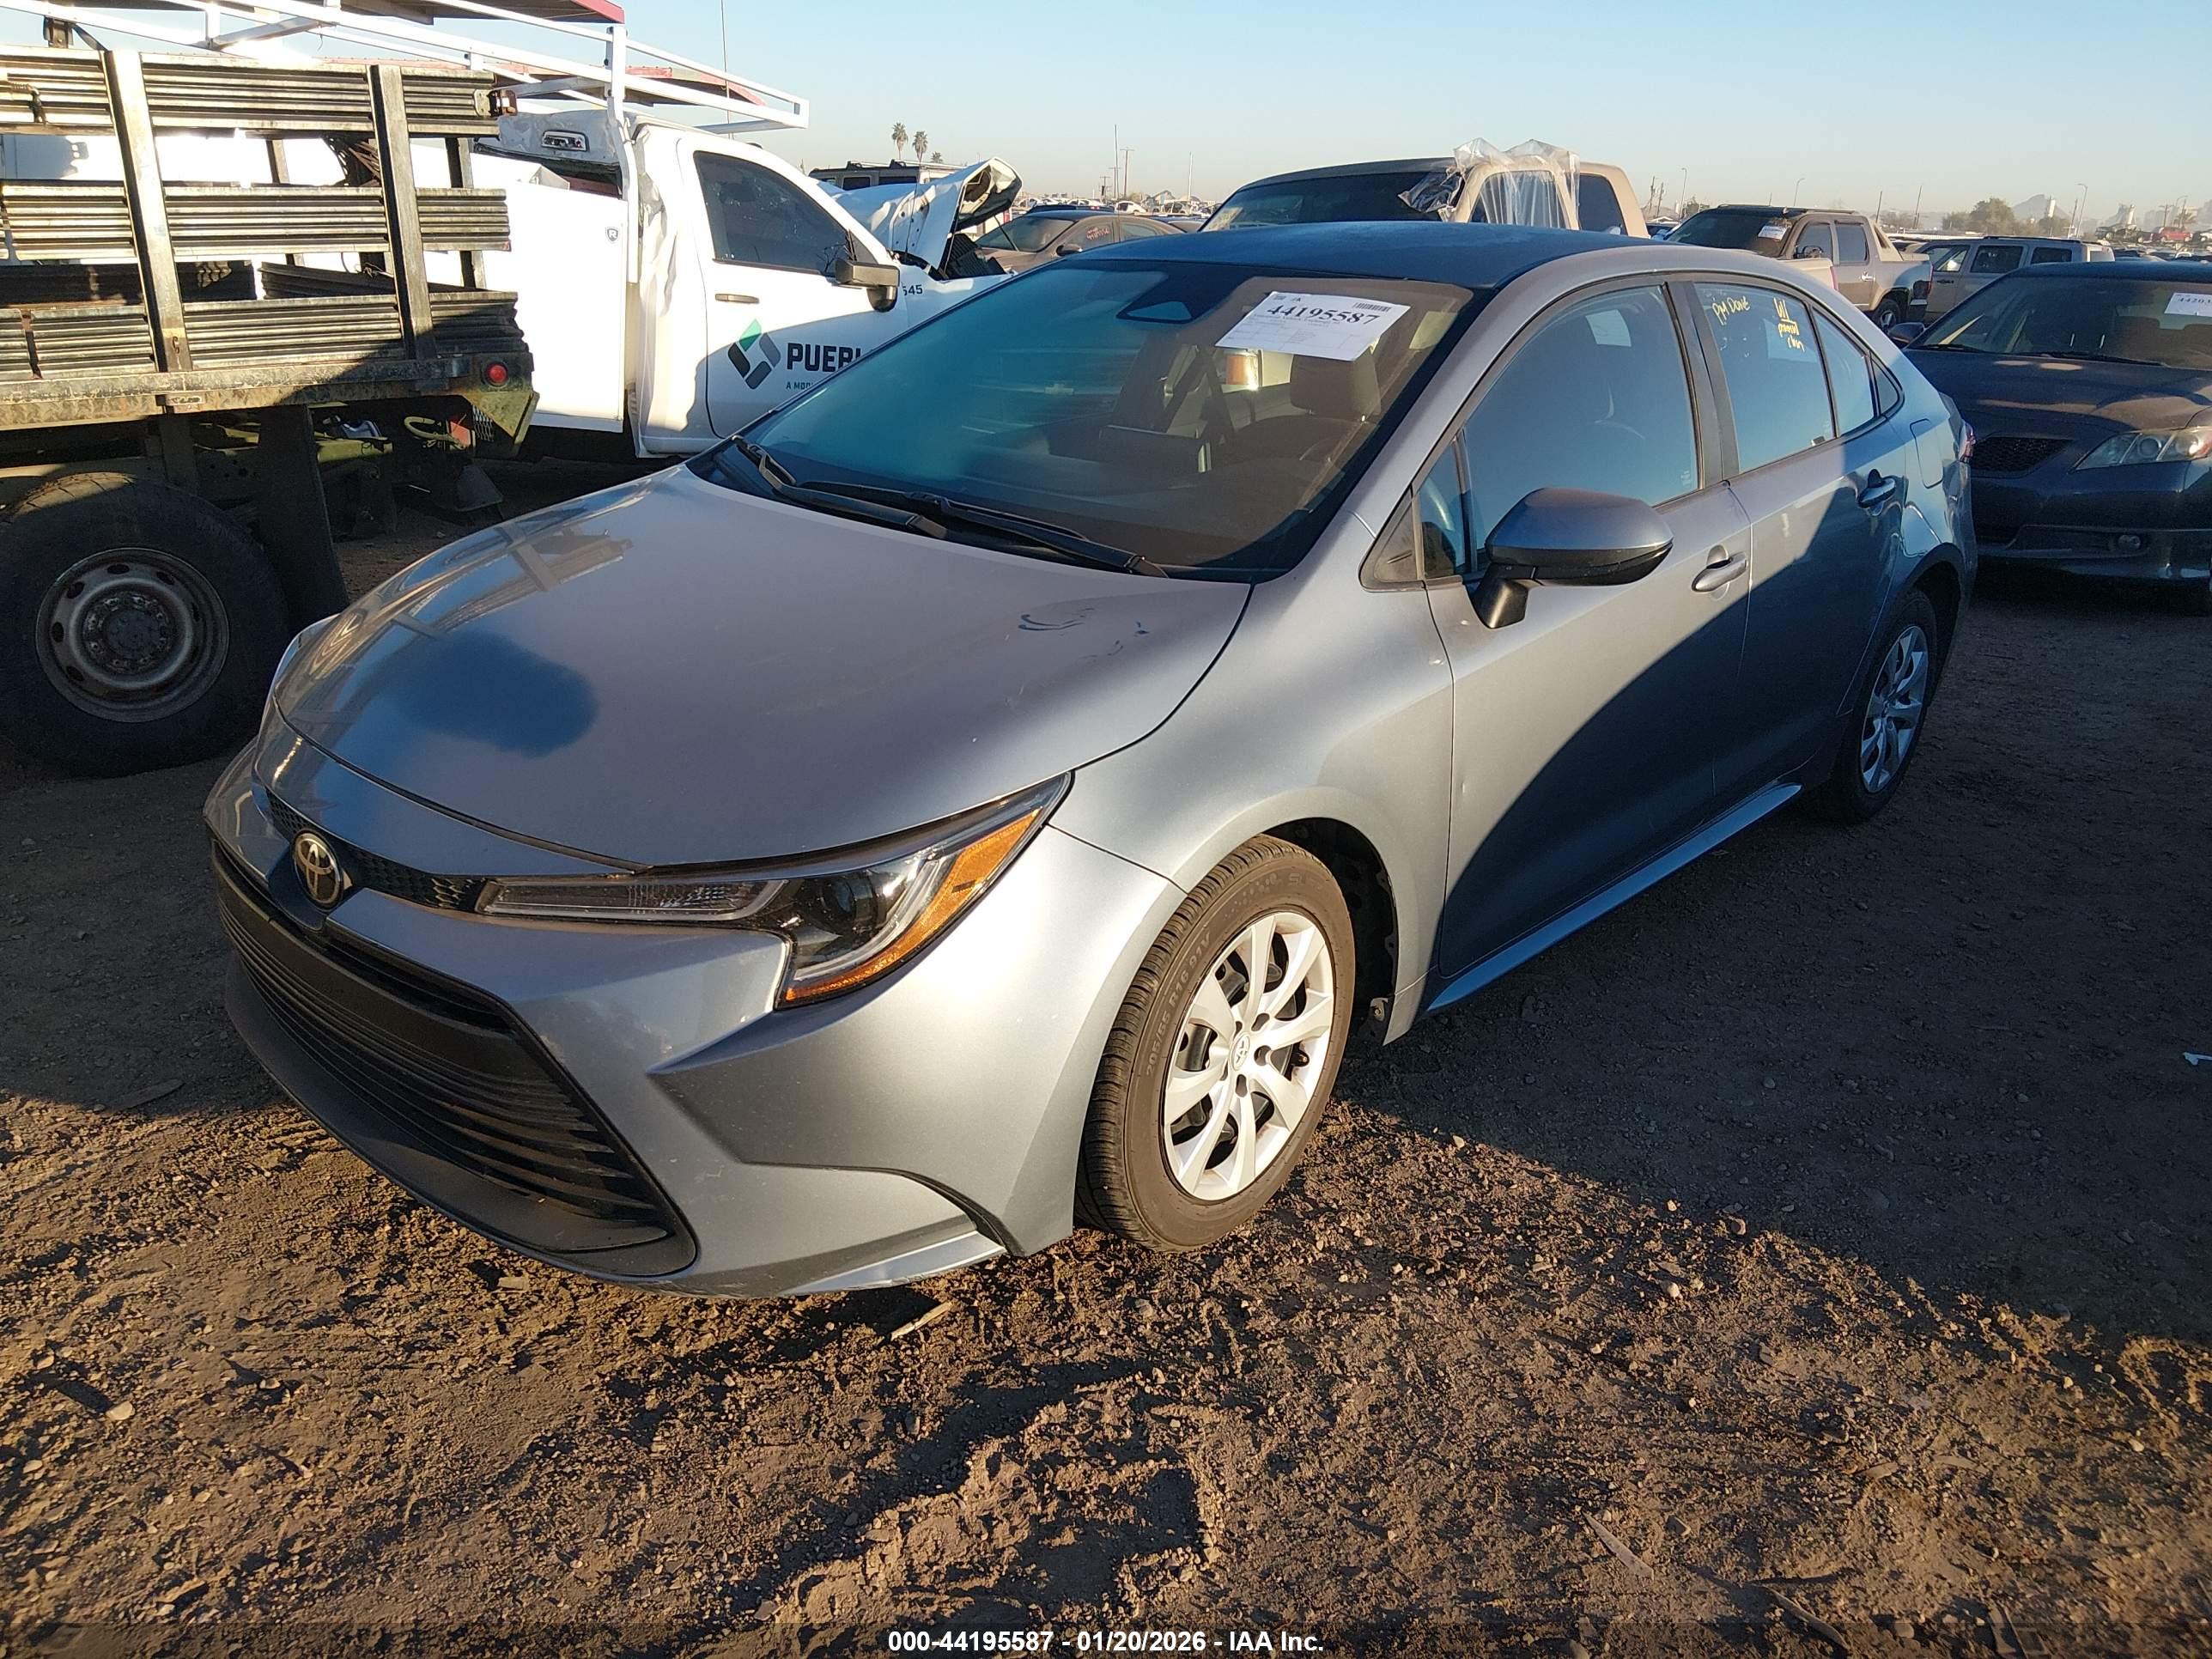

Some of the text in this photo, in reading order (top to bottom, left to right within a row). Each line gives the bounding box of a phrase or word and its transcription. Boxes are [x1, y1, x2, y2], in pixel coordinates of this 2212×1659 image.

[1267, 305, 1381, 325] 44195587
[1146, 932, 1211, 1076] 205/55 R16 91V
